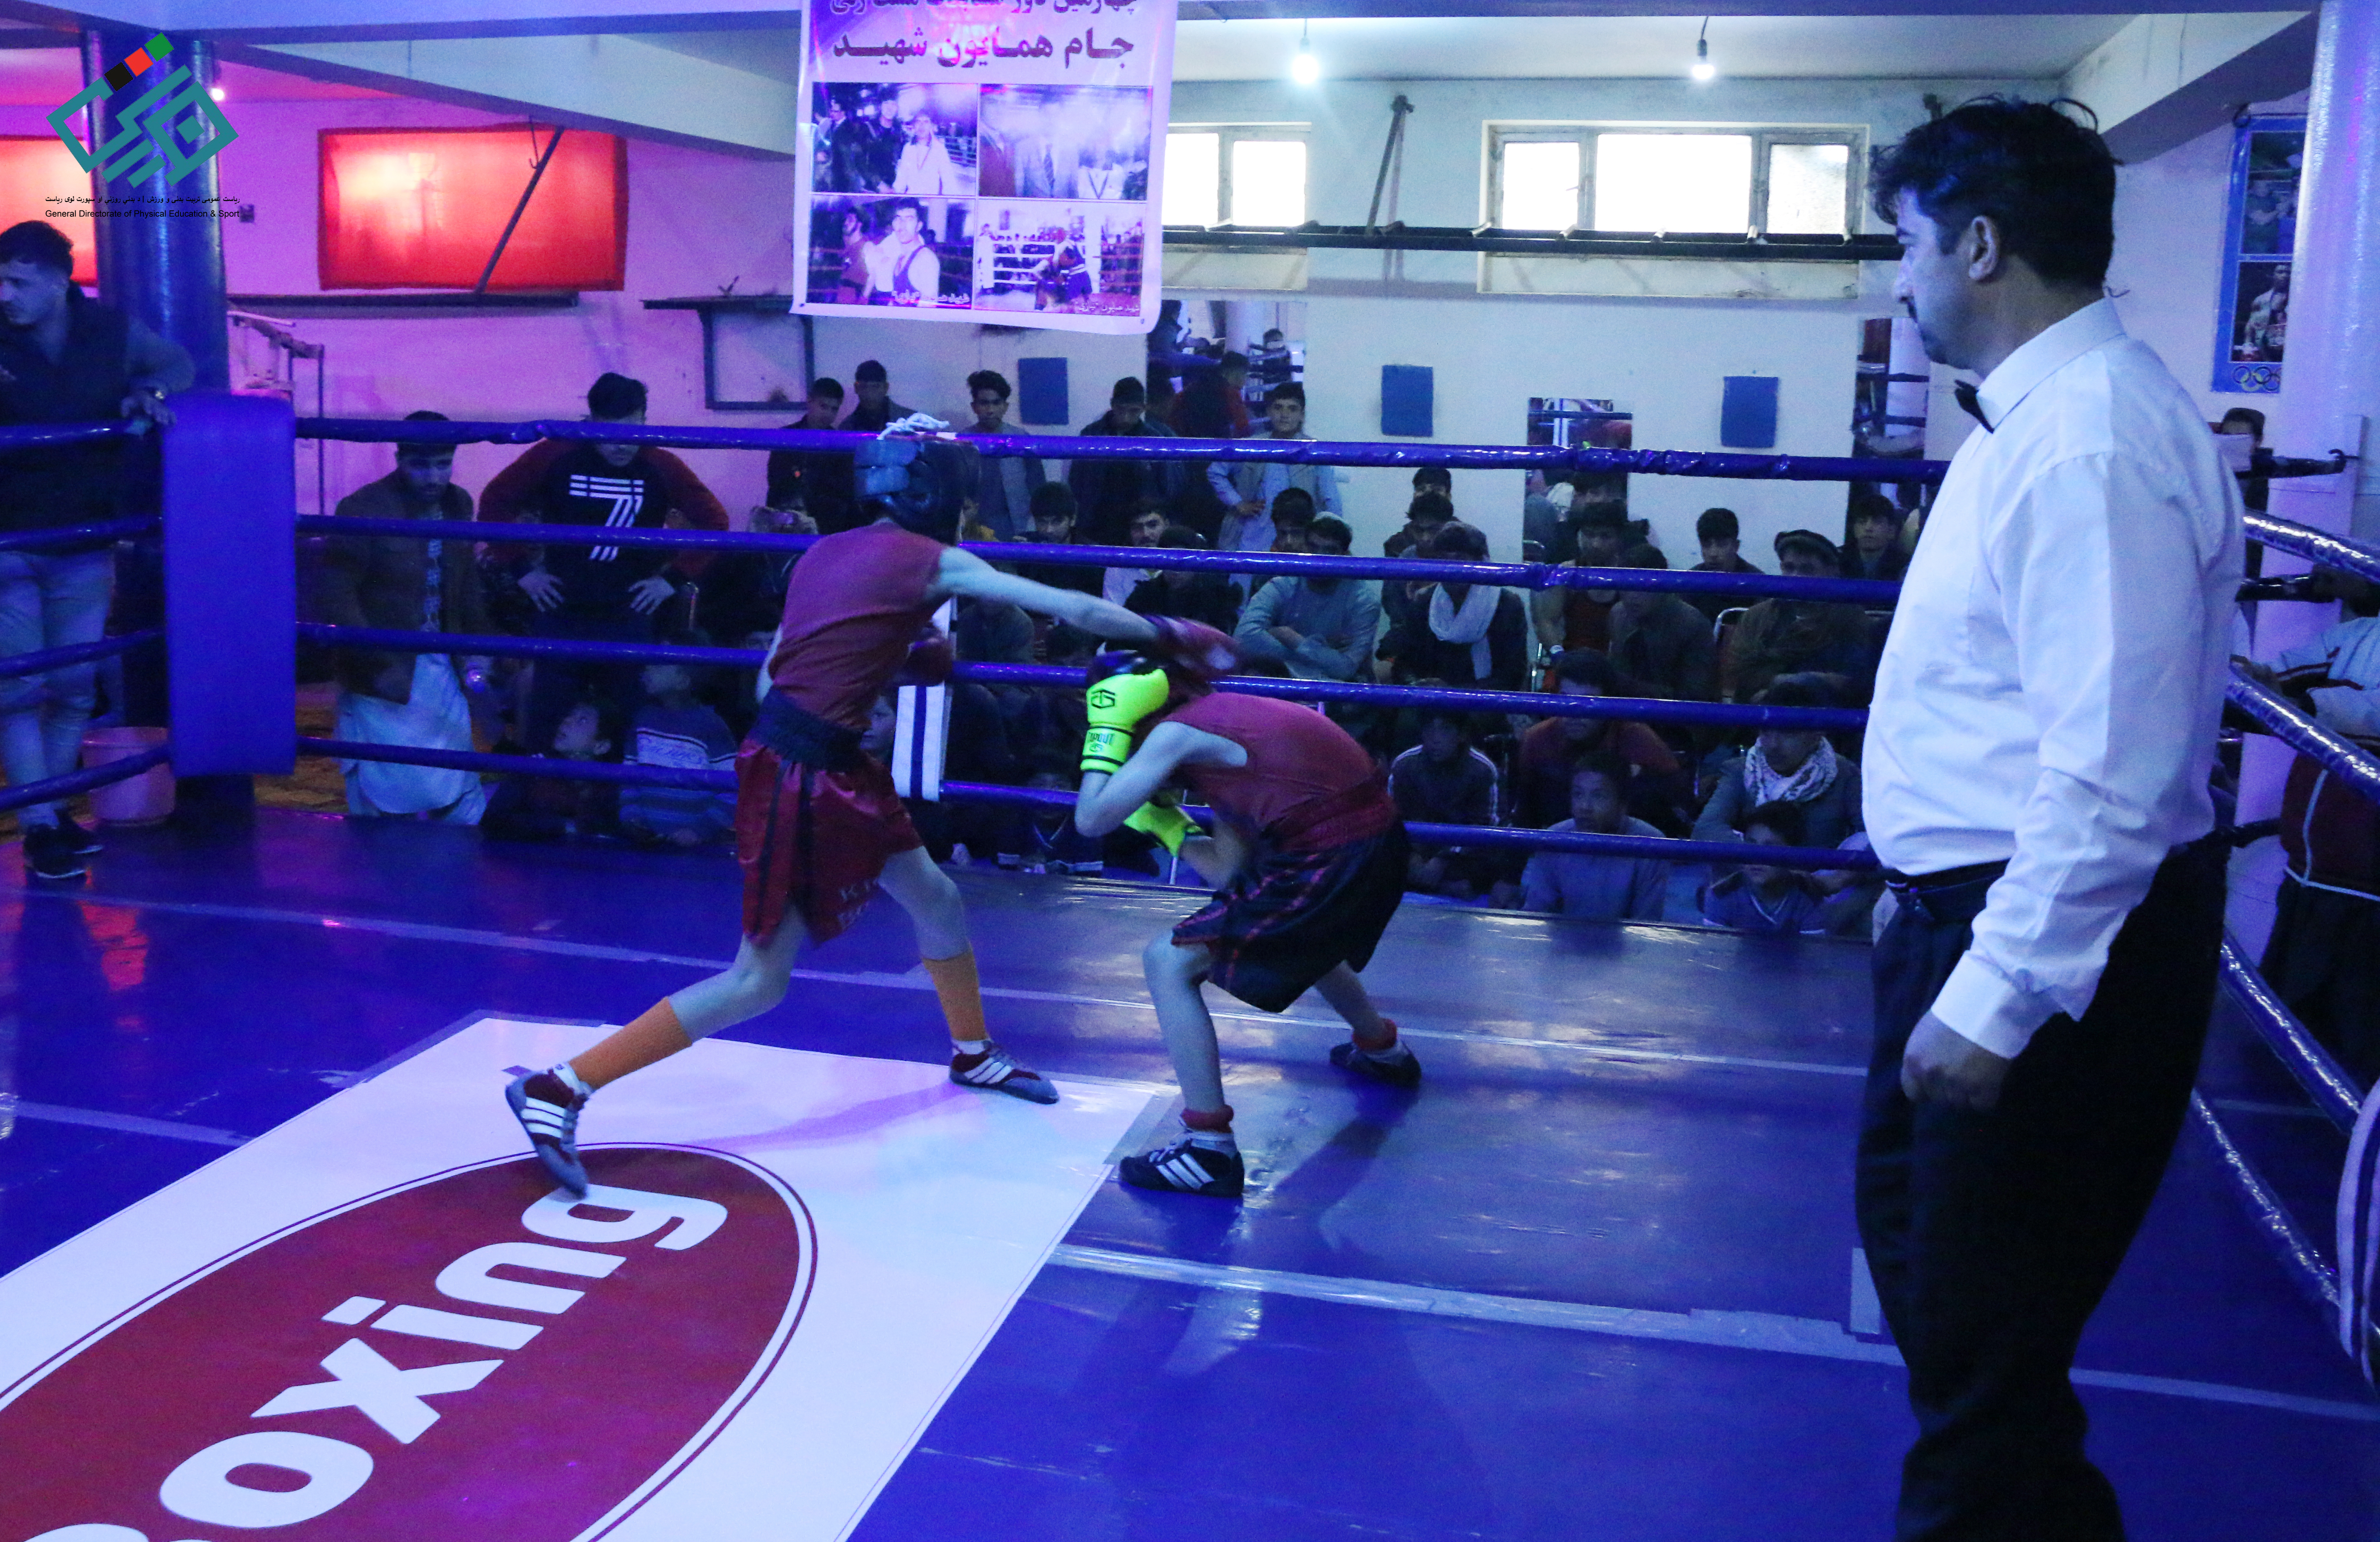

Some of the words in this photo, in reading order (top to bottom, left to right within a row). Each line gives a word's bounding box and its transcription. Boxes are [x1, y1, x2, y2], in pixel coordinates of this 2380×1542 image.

[833, 26, 928, 64] شهید
[937, 26, 1053, 68] همایون
[1064, 27, 1134, 69] جام
[22, 1183, 728, 1542] oxing
